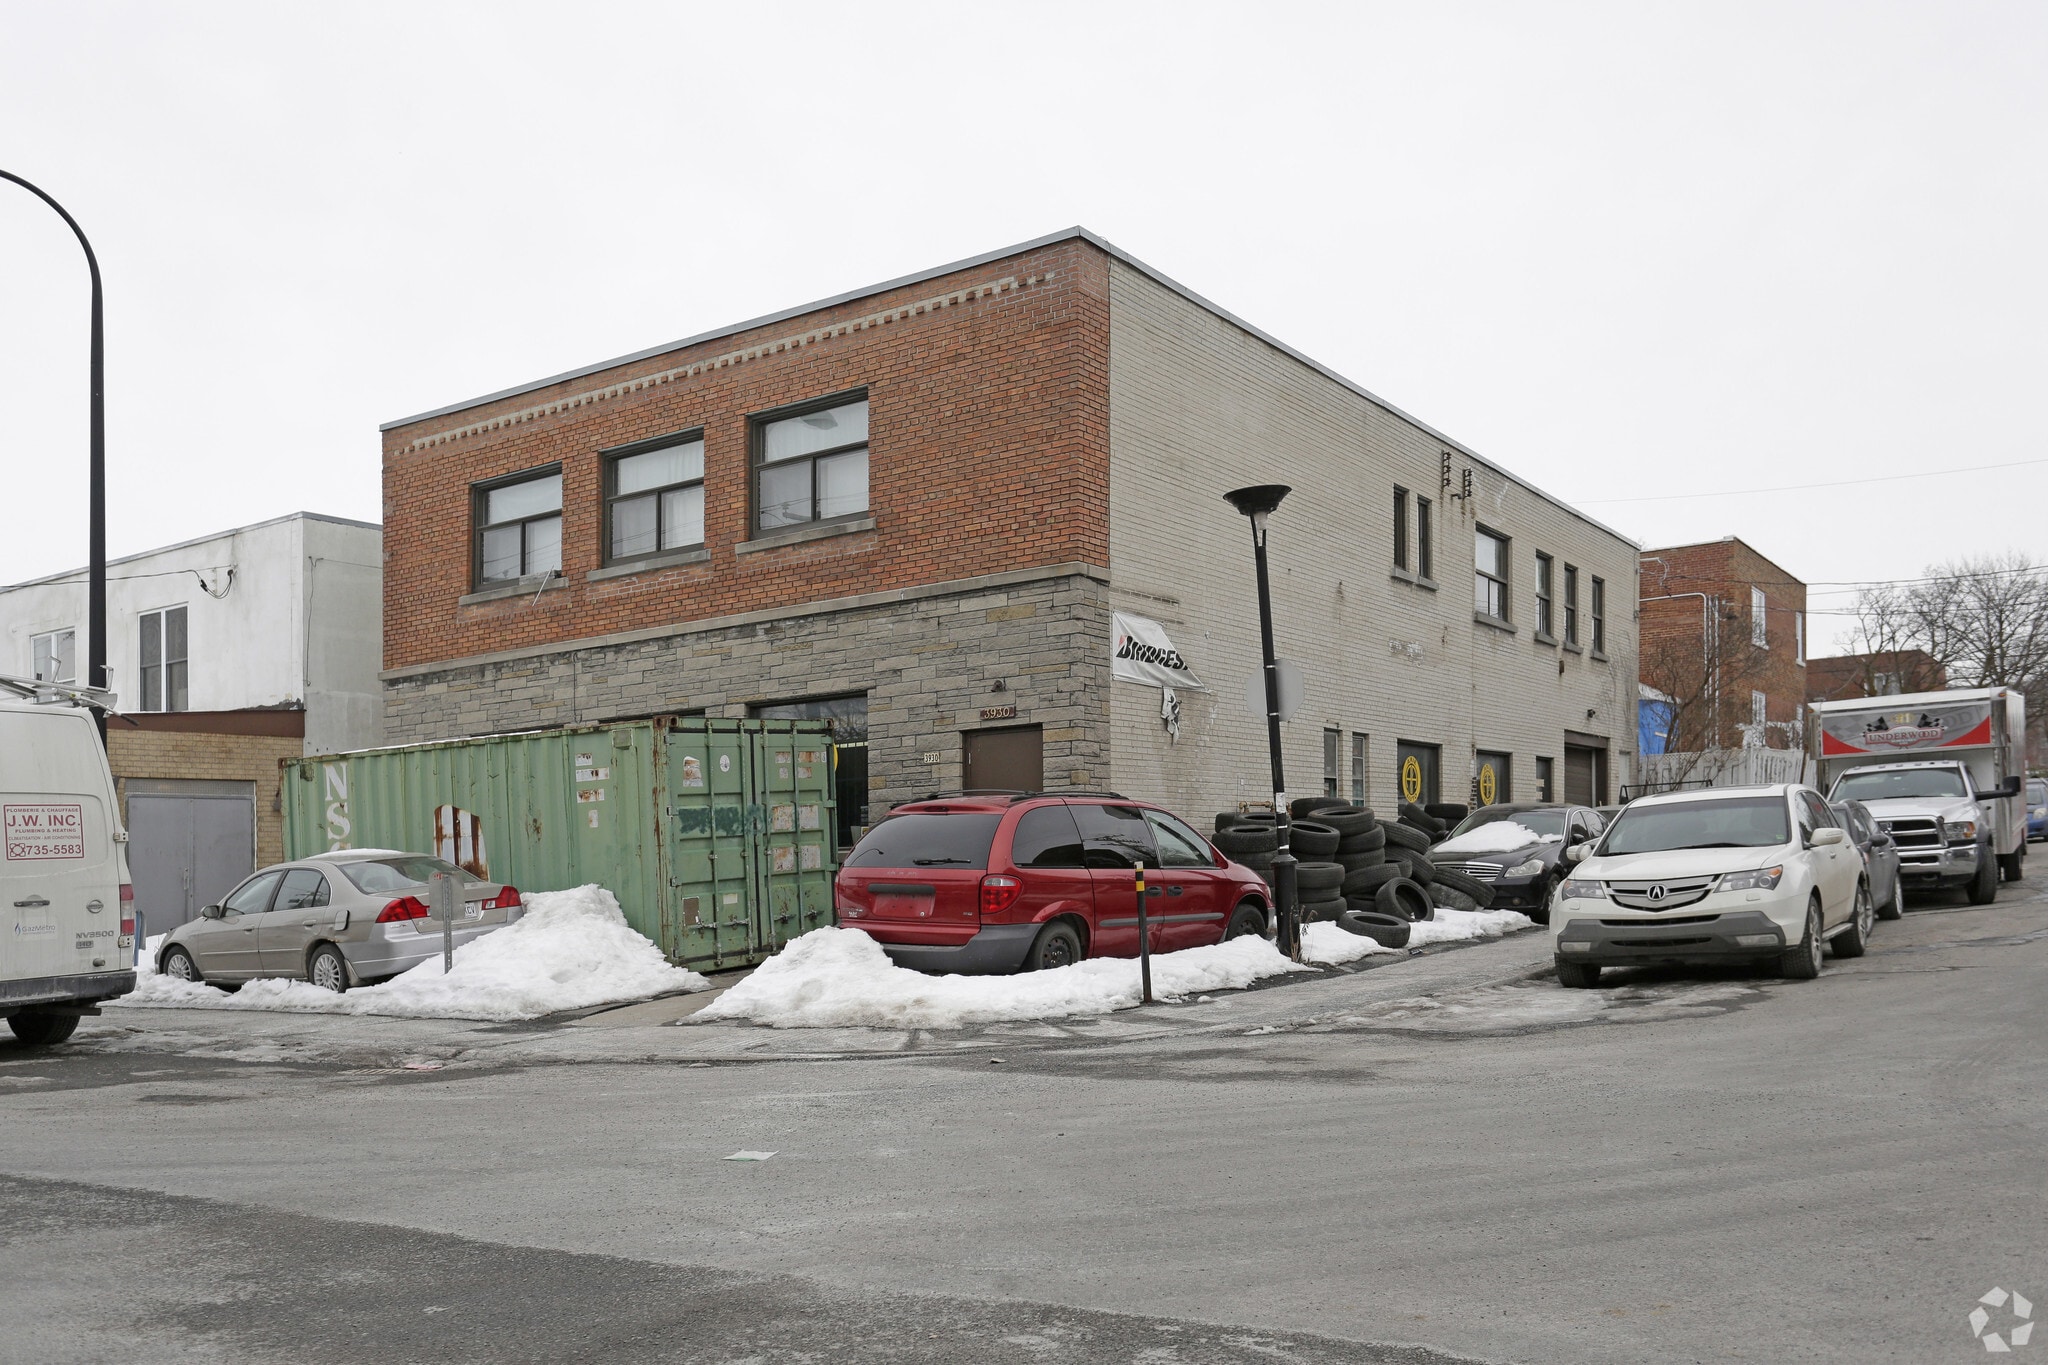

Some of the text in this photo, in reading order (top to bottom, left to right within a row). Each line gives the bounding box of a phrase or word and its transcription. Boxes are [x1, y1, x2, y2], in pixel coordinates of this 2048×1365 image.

[1116, 636, 1188, 670] BRIDGES
[984, 707, 1010, 719] 3930
[1869, 730, 1938, 741] UNDERWOOD
[925, 753, 939, 763] 3930
[7, 814, 80, 826] J.W. INC.
[26, 844, 81, 855] 735-5583
[76, 930, 114, 938] NV3500
